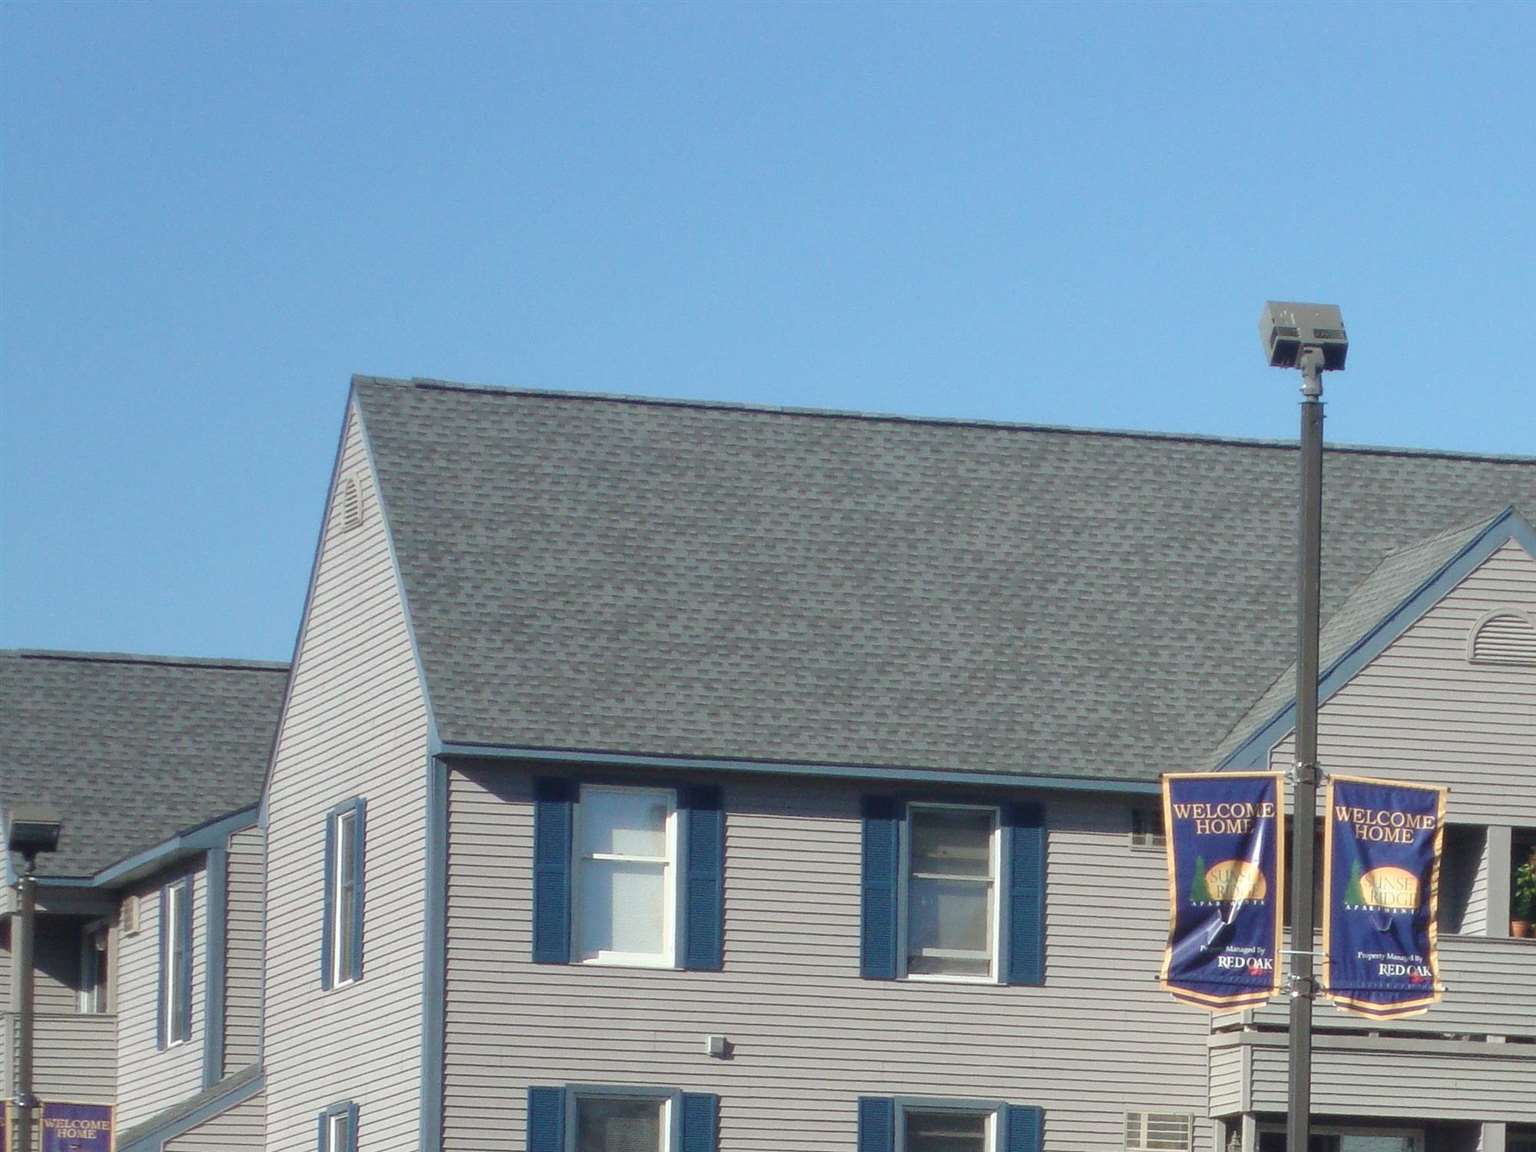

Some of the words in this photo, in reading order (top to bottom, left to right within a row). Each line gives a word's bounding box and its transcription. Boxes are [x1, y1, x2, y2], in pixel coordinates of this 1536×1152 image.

[1173, 802, 1275, 819] WELCOME
[1335, 806, 1436, 830] WELCOME
[1355, 824, 1414, 844] HOME
[1217, 955, 1245, 969] RED
[1246, 957, 1273, 970] OAK
[1379, 963, 1406, 976] RED
[1407, 965, 1432, 977] OAK
[44, 1118, 110, 1130] WELCOME
[57, 1128, 97, 1139] HOME
